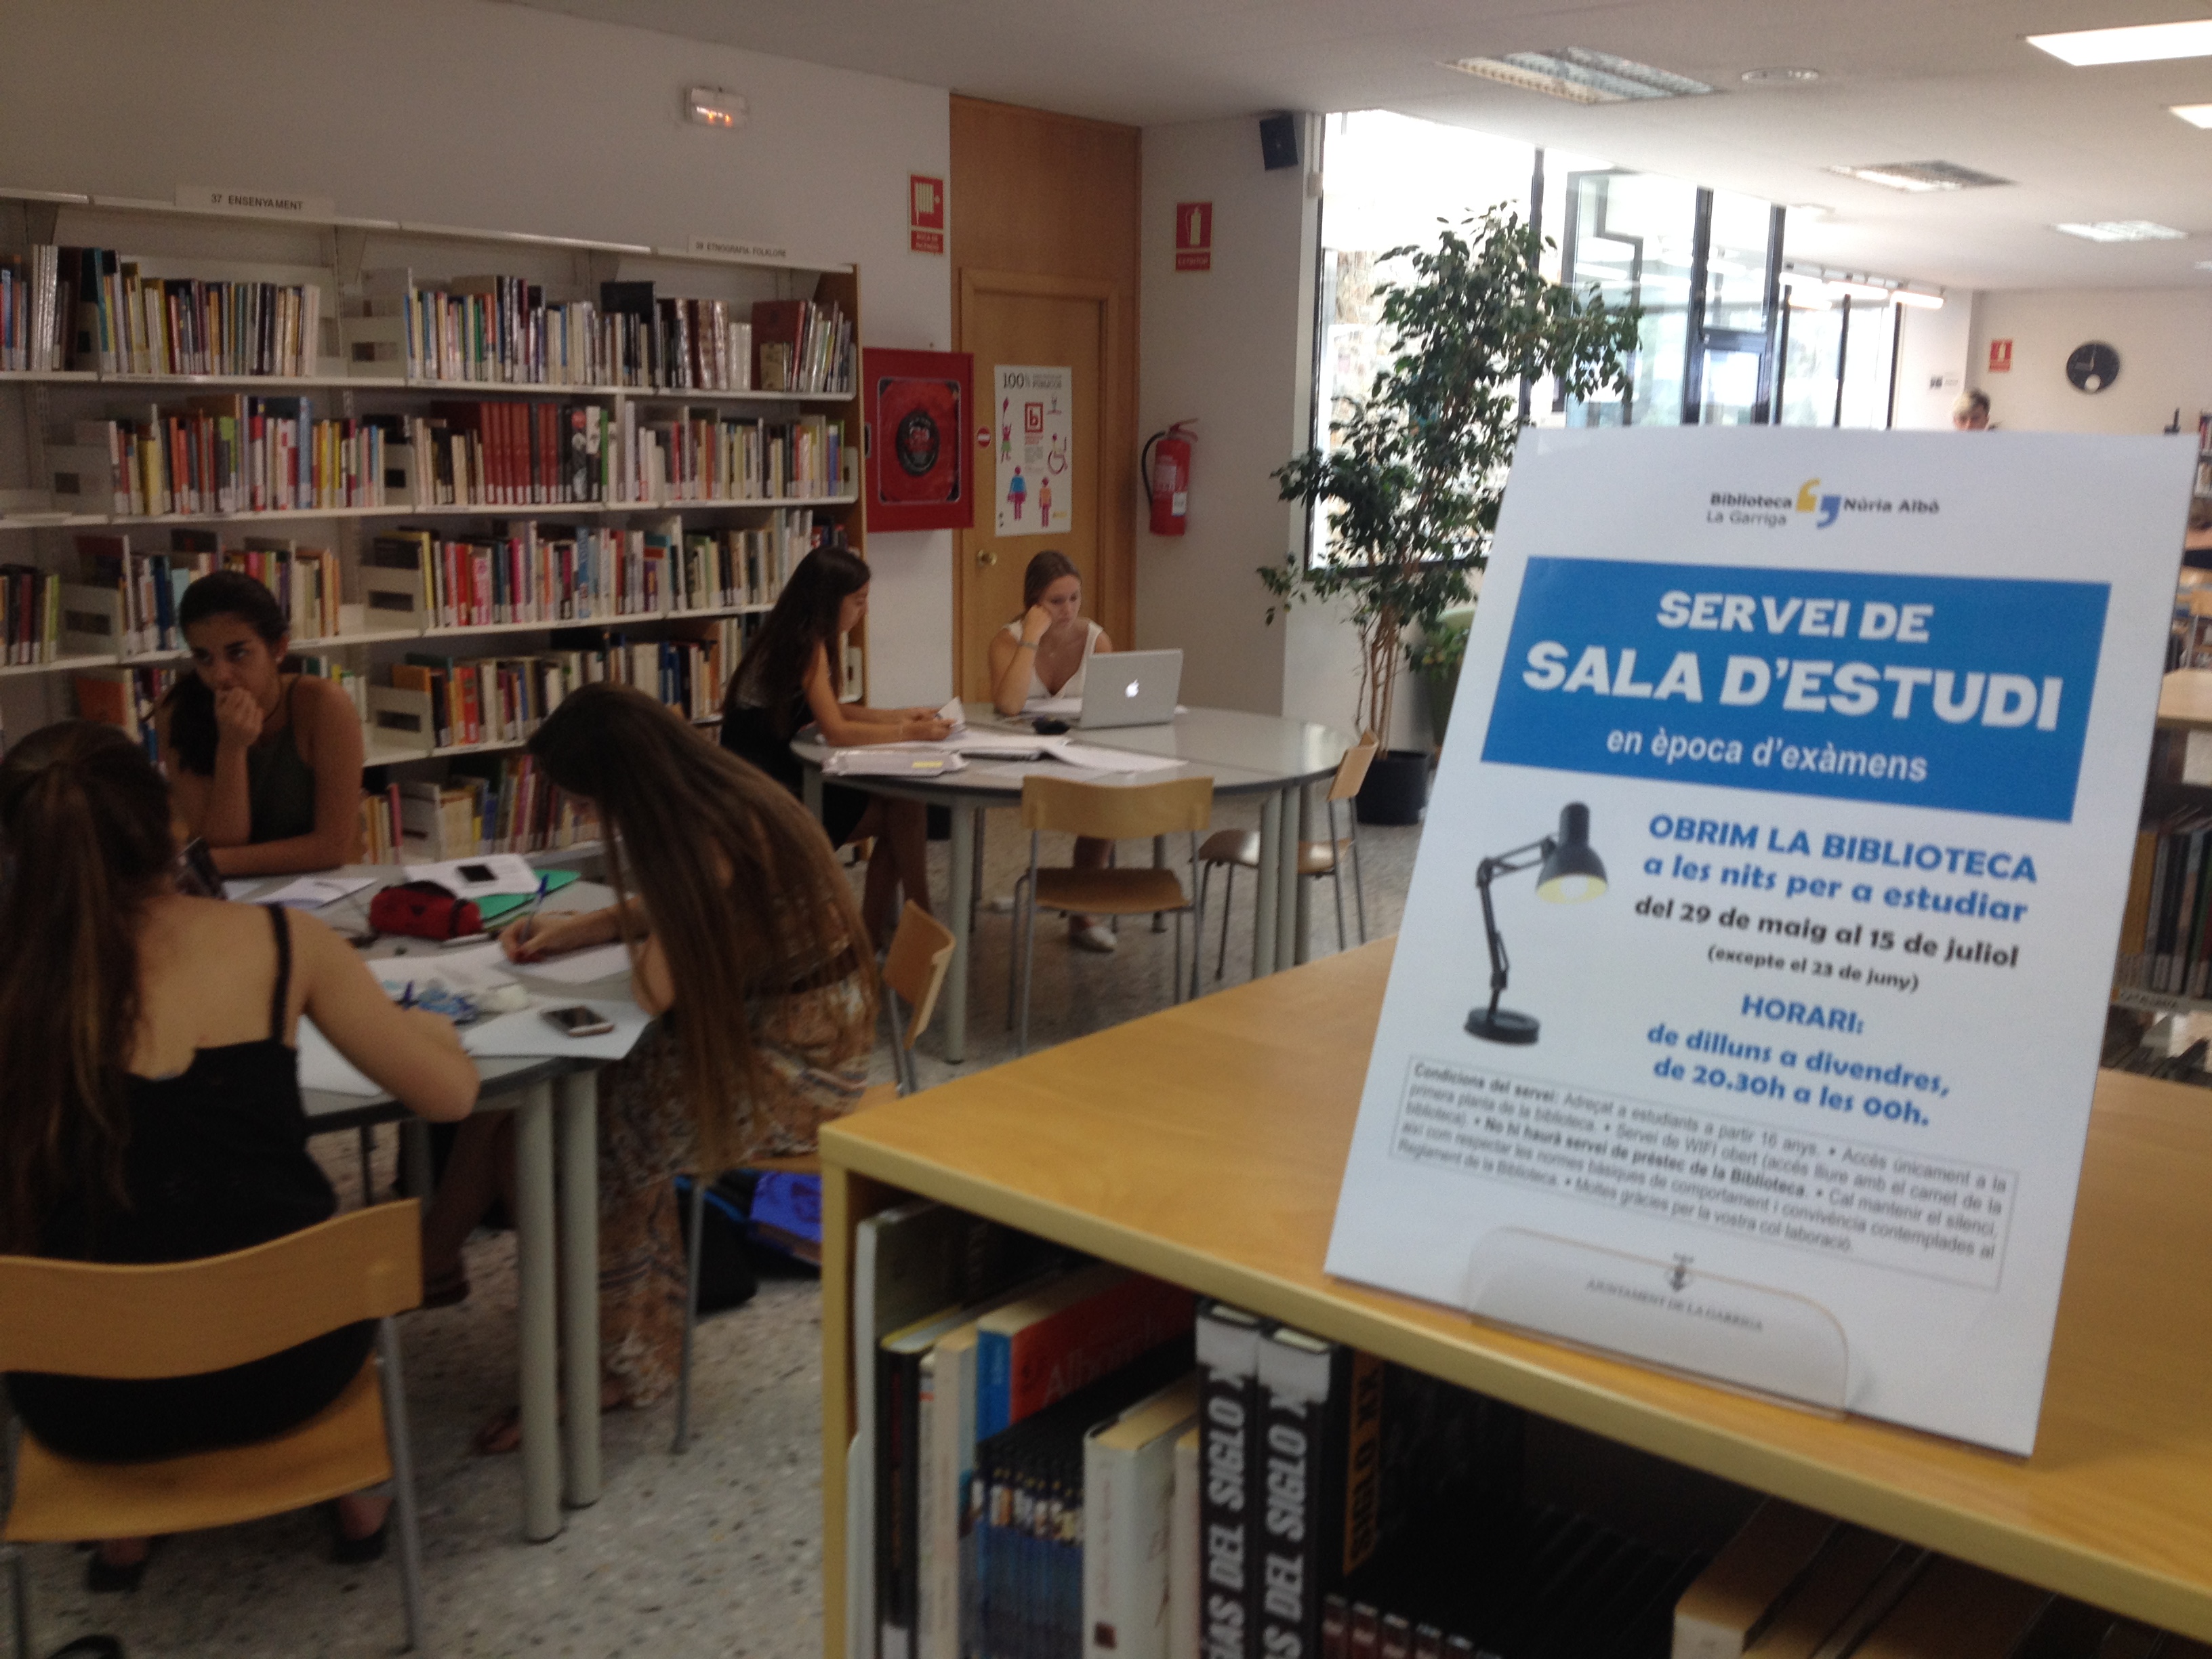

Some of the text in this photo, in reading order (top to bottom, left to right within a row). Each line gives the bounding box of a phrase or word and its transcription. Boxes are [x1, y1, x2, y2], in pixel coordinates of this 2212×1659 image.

[210, 193, 304, 210] 37 ENSENYAMENT
[1706, 510, 1788, 529] La Garriga
[1710, 491, 1793, 510] Biblioteca
[1843, 496, 1893, 514] Núria
[1657, 590, 1935, 643] SERVEI DE
[1523, 640, 1704, 704] SALA
[1607, 729, 1643, 754] en
[1650, 726, 1744, 767] època
[1649, 813, 2039, 884] OBRIM LA BIBLIOTECA
[1643, 854, 2030, 924] a les nits per a estudiar
[1635, 896, 2020, 969] del 29 de maig al 15 de juliol
[1707, 945, 1785, 972] (excepte
[1790, 956, 1807, 975] el
[1838, 962, 1863, 983] de
[1866, 967, 1920, 994] juny)
[1740, 994, 1865, 1036] HORARI:
[1646, 1021, 1951, 1099] de dilluns a divendres,
[1653, 1057, 1685, 1081] de
[1692, 1064, 1786, 1101] 20.30h
[1793, 1085, 1811, 1105] a
[1818, 1086, 1854, 1113] les
[1408, 1082, 1456, 1104] primera
[1458, 1092, 1496, 1113] planta
[1498, 1099, 1516, 1116] de
[1518, 1103, 1532, 1119] la
[1616, 1121, 1660, 1144] Servei
[1661, 1131, 1680, 1151] de
[1721, 1145, 1758, 1166] obert
[1814, 1160, 1849, 1185] lliure
[1853, 1172, 1887, 1193] amb
[1891, 1178, 1908, 1197] el
[1909, 1184, 1959, 1208] carnet
[1962, 1192, 1983, 1213] de
[1986, 1195, 2003, 1218] la
[1414, 1061, 1486, 1090] Condicions
[1489, 1078, 1512, 1094] del
[1618, 1105, 1627, 1118] a
[1631, 1107, 1699, 1132] estudiants
[1704, 1121, 1714, 1136] a
[1717, 1122, 1757, 1143] partir
[1975, 1174, 1987, 1190] a
[1992, 1174, 2008, 1193] la
[1397, 1136, 1464, 1165] Reglament
[1463, 1152, 1481, 1170] de
[1482, 1155, 1496, 1172] la
[1574, 1176, 1618, 1202] Moltes
[1671, 1202, 1696, 1220] per
[1697, 1204, 1713, 1221] la
[1714, 1210, 1758, 1233] vostra
[1425, 1126, 1453, 1144] com
[1454, 1132, 1513, 1156] respectar
[1513, 1143, 1534, 1161] les
[1536, 1149, 1585, 1172] normes
[1648, 1172, 1668, 1191] de
[1670, 1179, 1770, 1214] comportament
[1869, 1221, 1975, 1258] contemplades
[1979, 1243, 1996, 1261] al
[1483, 1114, 1504, 1134] No
[1506, 1119, 1521, 1138] hi
[1565, 1134, 1608, 1156] servei
[1610, 1143, 1629, 1162] de
[1689, 1160, 1708, 1178] de
[1712, 1163, 1727, 1182] la
[1829, 1185, 1856, 1209] Cal
[1857, 1195, 1923, 1223] mantenir
[1926, 1208, 1944, 1227] el
[1207, 1396, 1246, 1513] SIGLO
[1265, 1424, 1308, 1542] SIGLO
[1208, 1523, 1246, 1591] DEL
[1264, 1552, 1304, 1622] DEL
